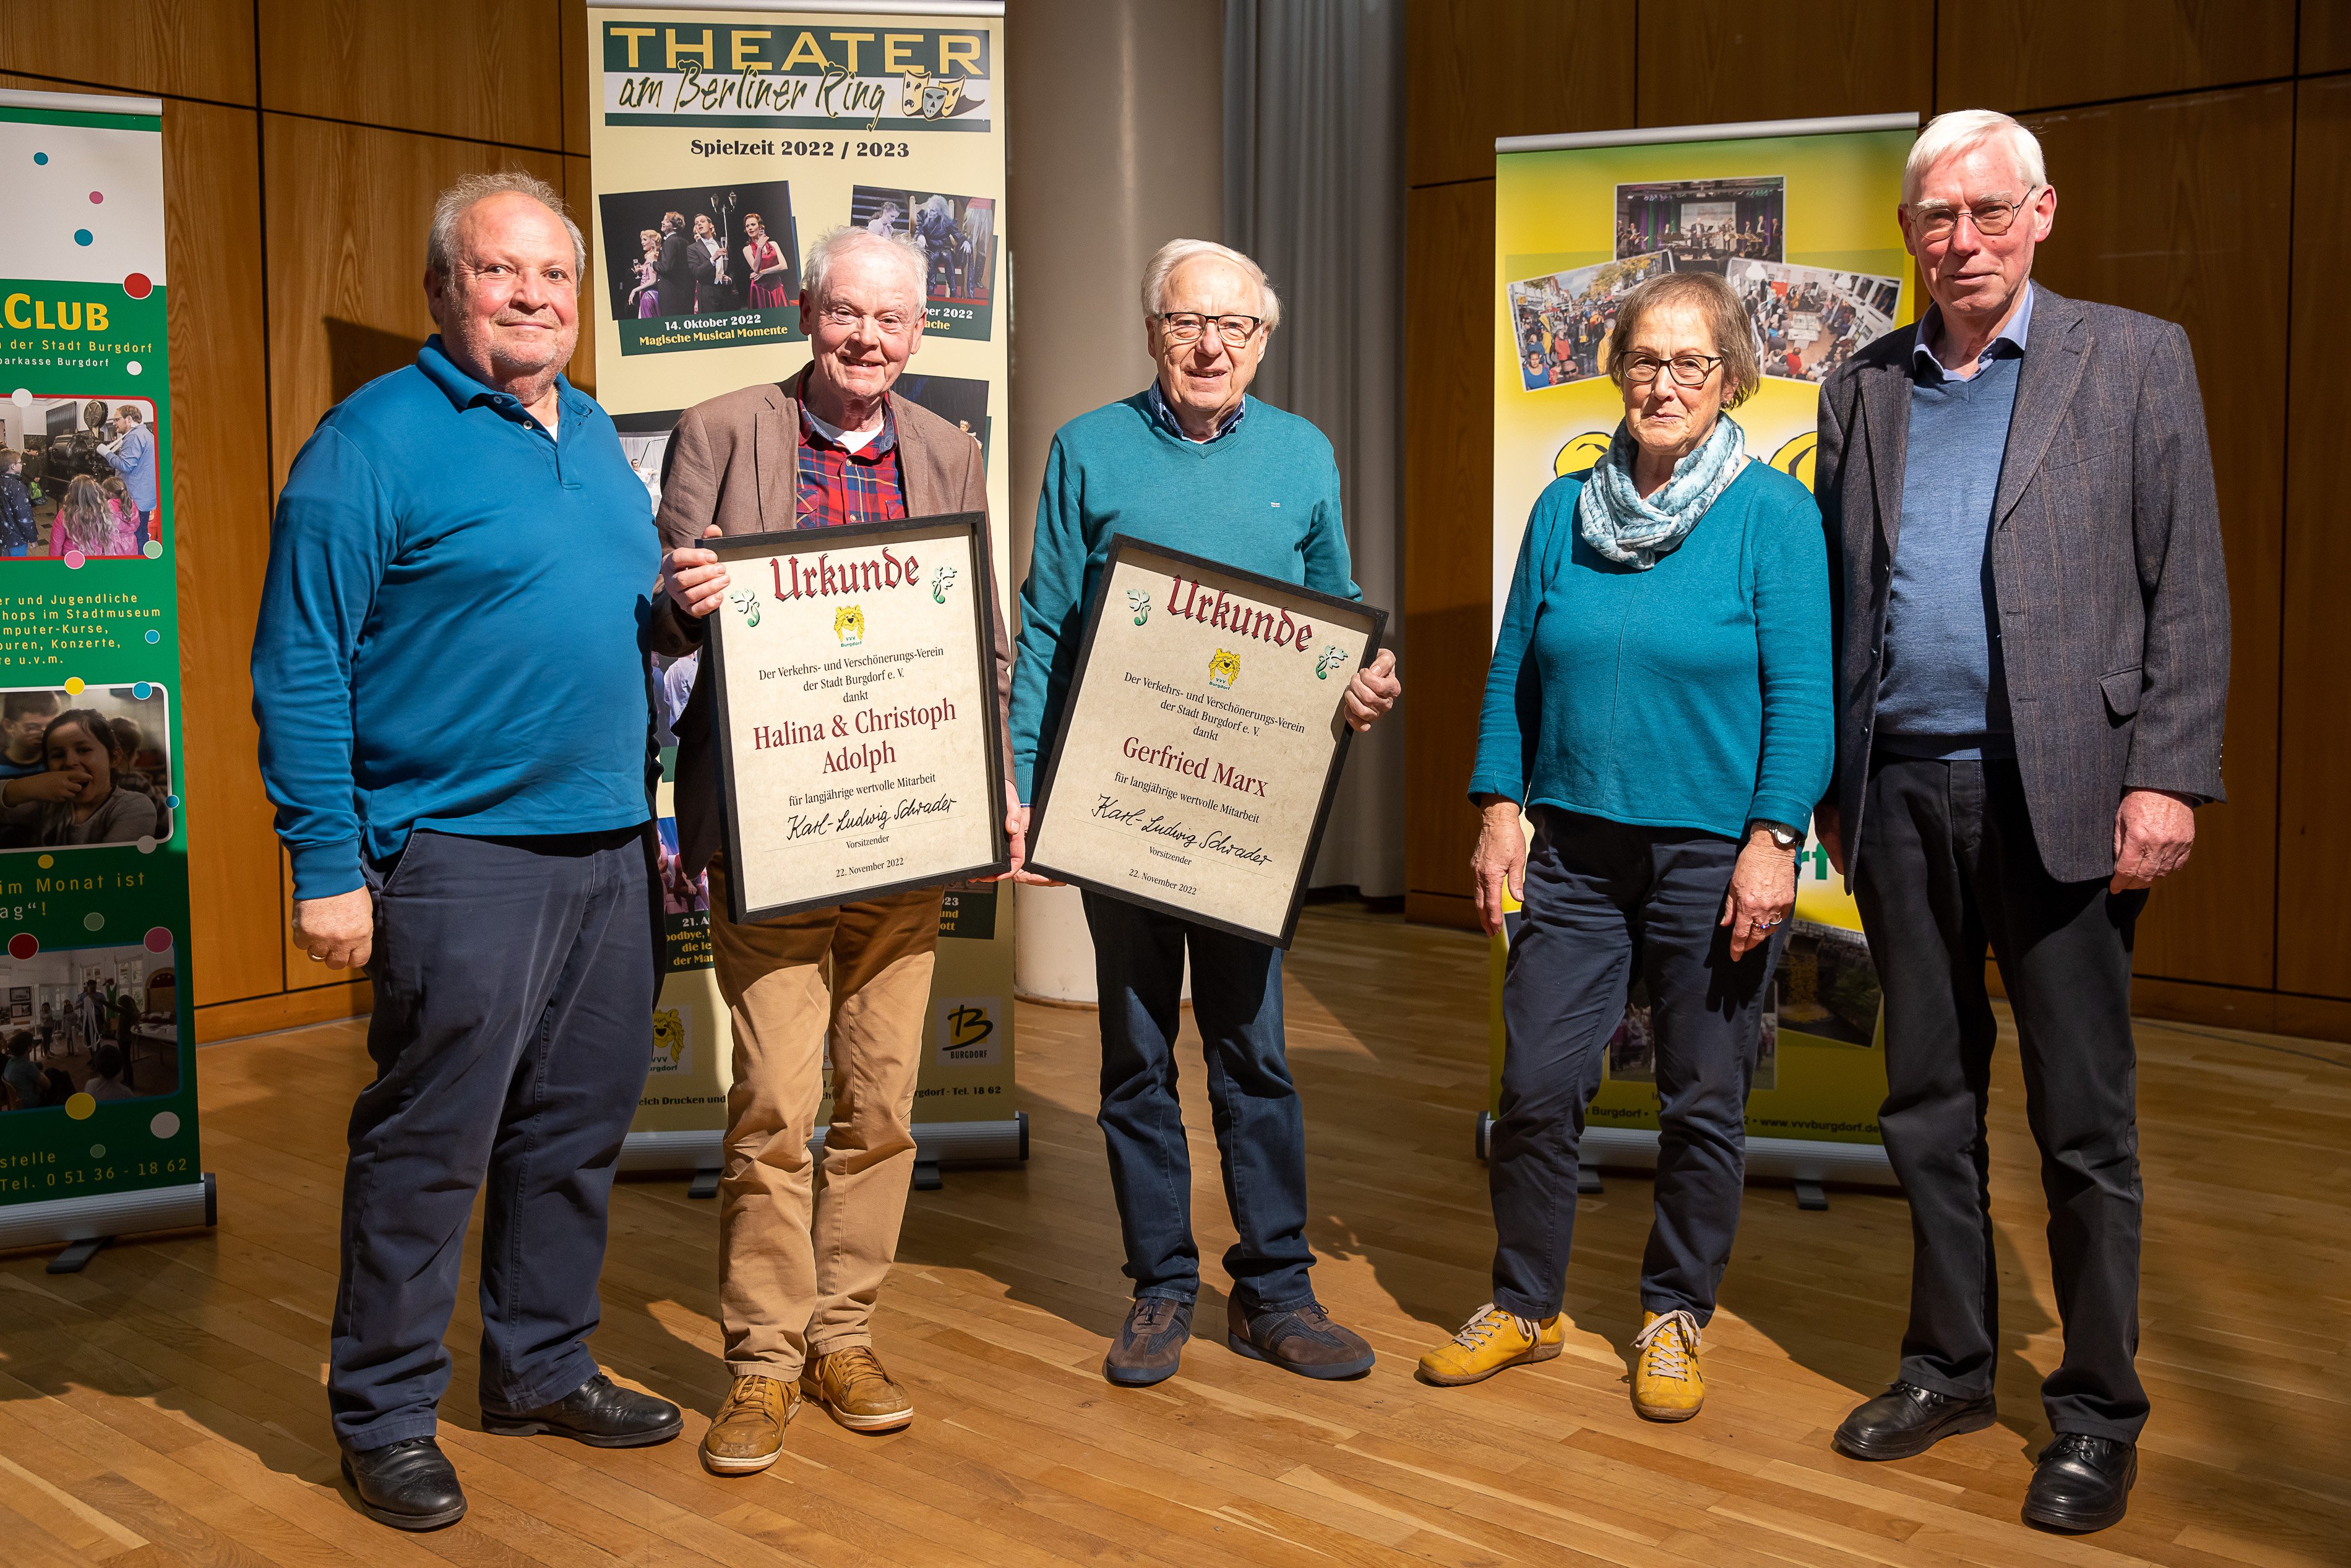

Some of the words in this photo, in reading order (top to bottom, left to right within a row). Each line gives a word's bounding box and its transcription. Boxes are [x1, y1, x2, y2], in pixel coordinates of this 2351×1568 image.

[610, 27, 984, 75] THEATER
[619, 77, 663, 110] am
[674, 60, 807, 113] Berliner
[815, 61, 885, 132] Ring
[690, 139, 775, 157] Spielzeit
[780, 141, 834, 156] 2022
[841, 141, 849, 160] /
[856, 142, 909, 158] 2023
[0, 293, 109, 331] CLUB
[664, 321, 681, 330] 14.
[684, 319, 728, 329] Oktober
[731, 314, 761, 325] 2022
[943, 308, 973, 319] 2022
[639, 334, 691, 346] Magische
[694, 329, 735, 341] Musical
[737, 325, 788, 338] Momente
[11, 339, 33, 349] der
[42, 340, 80, 351] Stadt
[89, 341, 152, 354] Burgdorf
[58, 358, 110, 367] Burgdorf
[770, 547, 919, 601] Urkunde
[18, 595, 43, 605] und
[51, 593, 137, 606] Jugendliche
[43, 610, 59, 619] im
[66, 608, 160, 619] Stadtmuseum
[1167, 574, 1313, 652] Urkunde
[51, 638, 121, 649] Konzerte,
[19, 654, 64, 665] u.v.m.
[759, 670, 775, 680] Der
[778, 664, 820, 677] Verkehrs-
[824, 659, 841, 670] und
[844, 647, 943, 667] Verschönerungs-Verein
[804, 681, 818, 691] der
[821, 677, 843, 688] Stadt
[846, 670, 885, 685] Burgdorf
[898, 669, 904, 677] V.
[1209, 681, 1230, 690] Burgdorf
[843, 690, 868, 703] dankt
[1124, 672, 1141, 684] Der
[1144, 677, 1183, 696] Verkehrs-
[1187, 692, 1204, 703] und
[1206, 696, 1305, 734] Verschönerungs-Verein
[754, 721, 825, 750] Halina
[832, 715, 849, 737] &
[856, 698, 956, 733] Christoph
[1161, 700, 1176, 711] der
[1177, 705, 1199, 718] Stadt
[1201, 711, 1242, 730] Burgdorf
[1254, 727, 1260, 736] V.
[1193, 726, 1218, 740] dankt
[823, 740, 896, 774] Adolph
[1124, 737, 1209, 779] Gerfried
[1212, 763, 1268, 797] Marx
[789, 796, 802, 806] für
[805, 788, 854, 804] langjährige
[856, 780, 895, 794] wertvolle
[898, 774, 935, 787] Mitarbeit
[1115, 772, 1128, 784] für
[1130, 776, 1177, 799] langjährige
[1180, 794, 1218, 810] wertvolle
[1220, 803, 1259, 823] Mitarbeit
[894, 793, 956, 820] Schrader
[846, 835, 889, 848] Vorsitzender
[1200, 831, 1272, 865] Schrader
[1150, 846, 1192, 865] Vorsitzender
[836, 868, 847, 878] 22.
[849, 862, 884, 874] November
[887, 858, 903, 867] 2022
[37, 875, 103, 893] Monat
[117, 872, 144, 888] ist
[1129, 869, 1140, 878] 22.
[1141, 873, 1177, 889] November
[1179, 884, 1197, 895] 2022
[942, 897, 959, 906] 23
[682, 917, 698, 927] 21.
[682, 943, 698, 952] die
[674, 957, 691, 966] der
[950, 1050, 987, 1059] BURGDORF
[663, 1097, 704, 1105] Drucken
[708, 1095, 726, 1103] und
[953, 1087, 969, 1095] Tel.
[988, 1086, 1001, 1094] 62
[1592, 1106, 1641, 1119] Burgdorf
[0, 1176, 35, 1192] Tel.
[47, 1173, 55, 1186] 0
[65, 1170, 85, 1184] 51
[95, 1167, 114, 1181] 36
[139, 1162, 158, 1175] 18
[167, 1159, 186, 1172] 62
